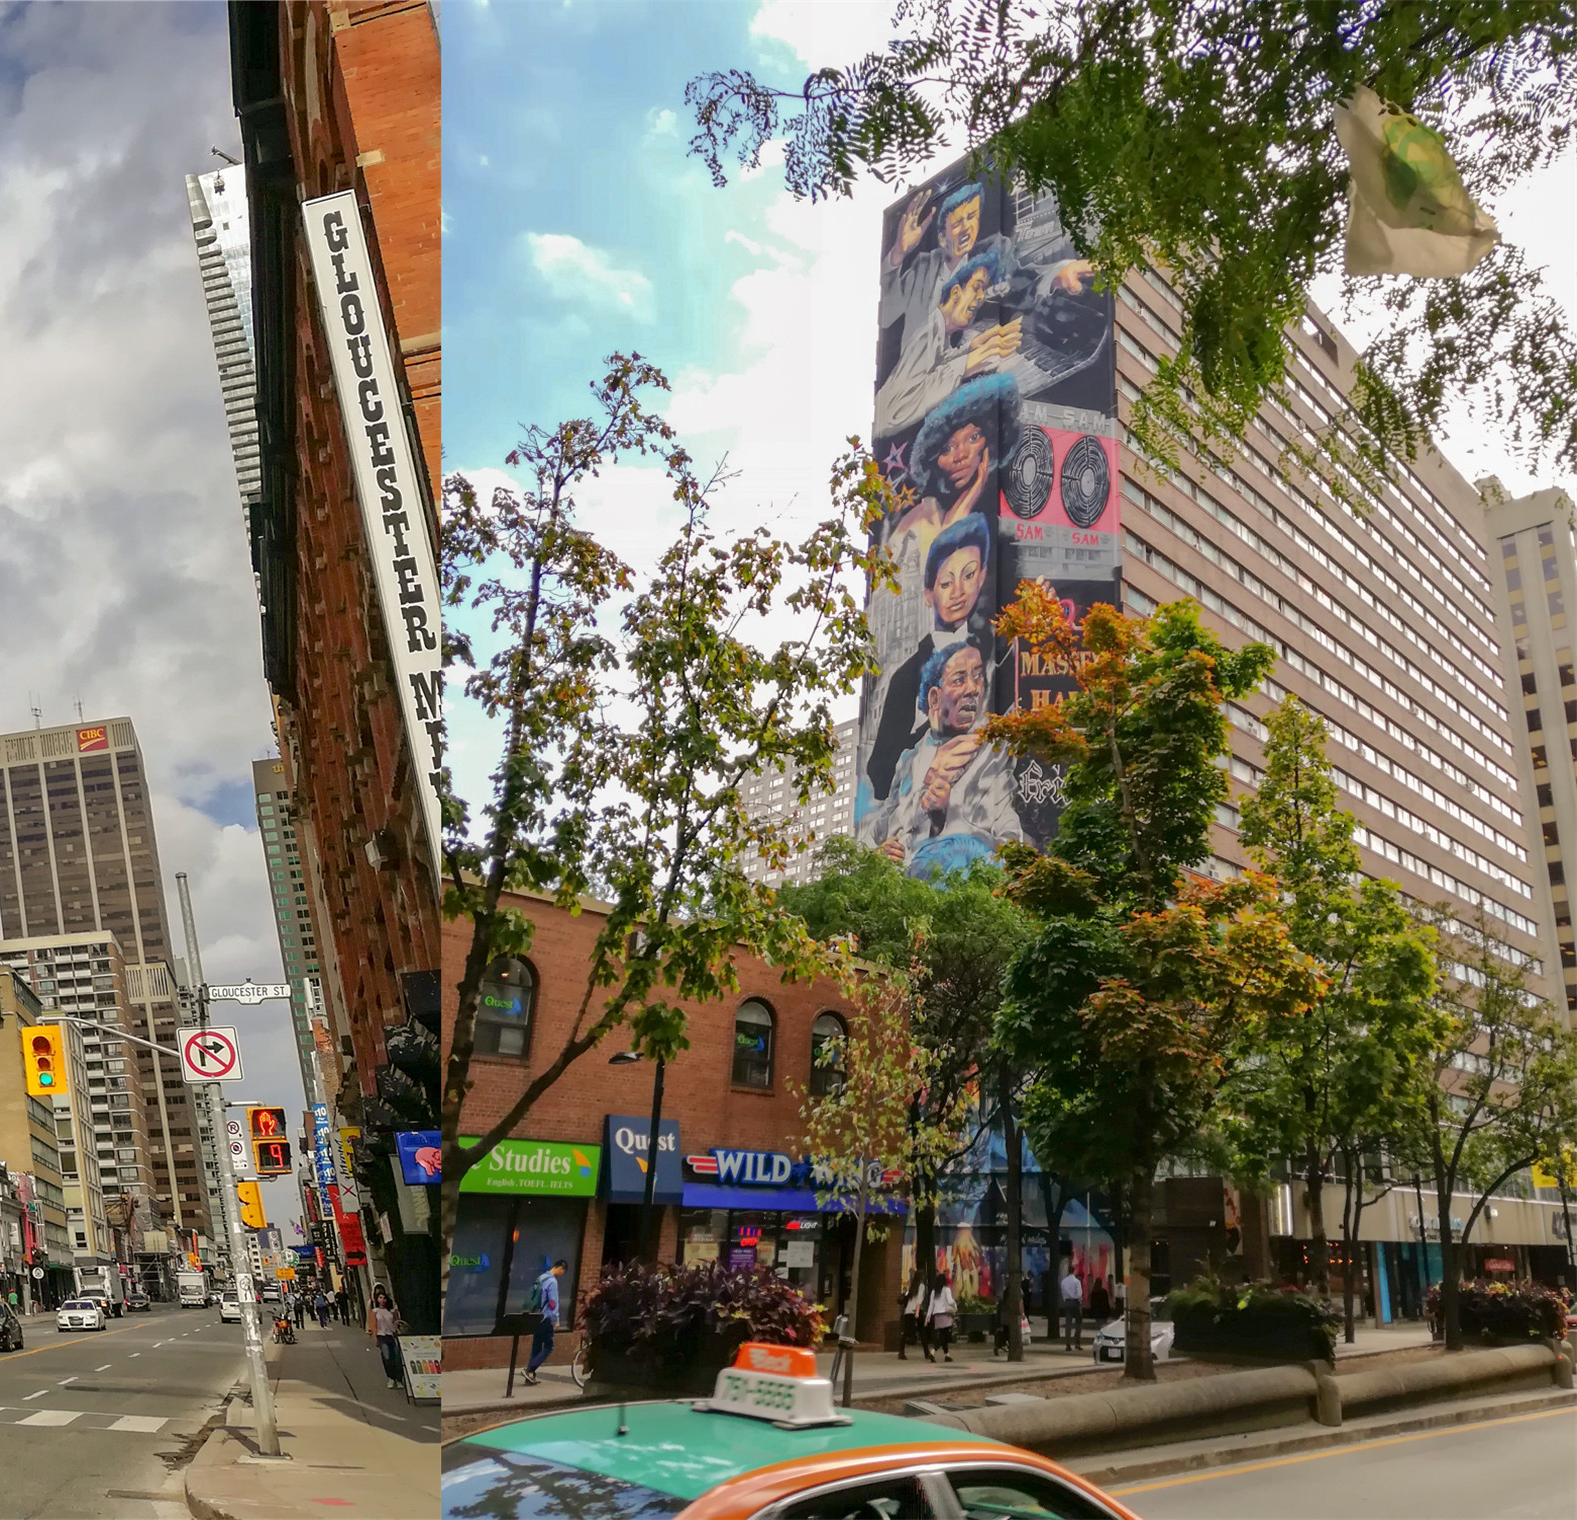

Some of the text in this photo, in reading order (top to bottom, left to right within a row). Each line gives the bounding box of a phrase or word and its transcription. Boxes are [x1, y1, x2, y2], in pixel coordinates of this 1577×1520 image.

[322, 210, 436, 654] GLOUCESTER
[1015, 523, 1043, 541] SAM
[1072, 532, 1099, 546] SAM
[79, 728, 104, 740] CIBC
[211, 986, 268, 998] GLOUCESTER
[615, 1127, 676, 1154] Qust
[270, 1143, 283, 1169] 9
[489, 1145, 571, 1175] Studies
[715, 1150, 793, 1184] WILD
[487, 1178, 573, 1190] English TOEFL IELTS
[800, 1221, 818, 1230] LIGHT
[449, 1255, 481, 1267] Quest
